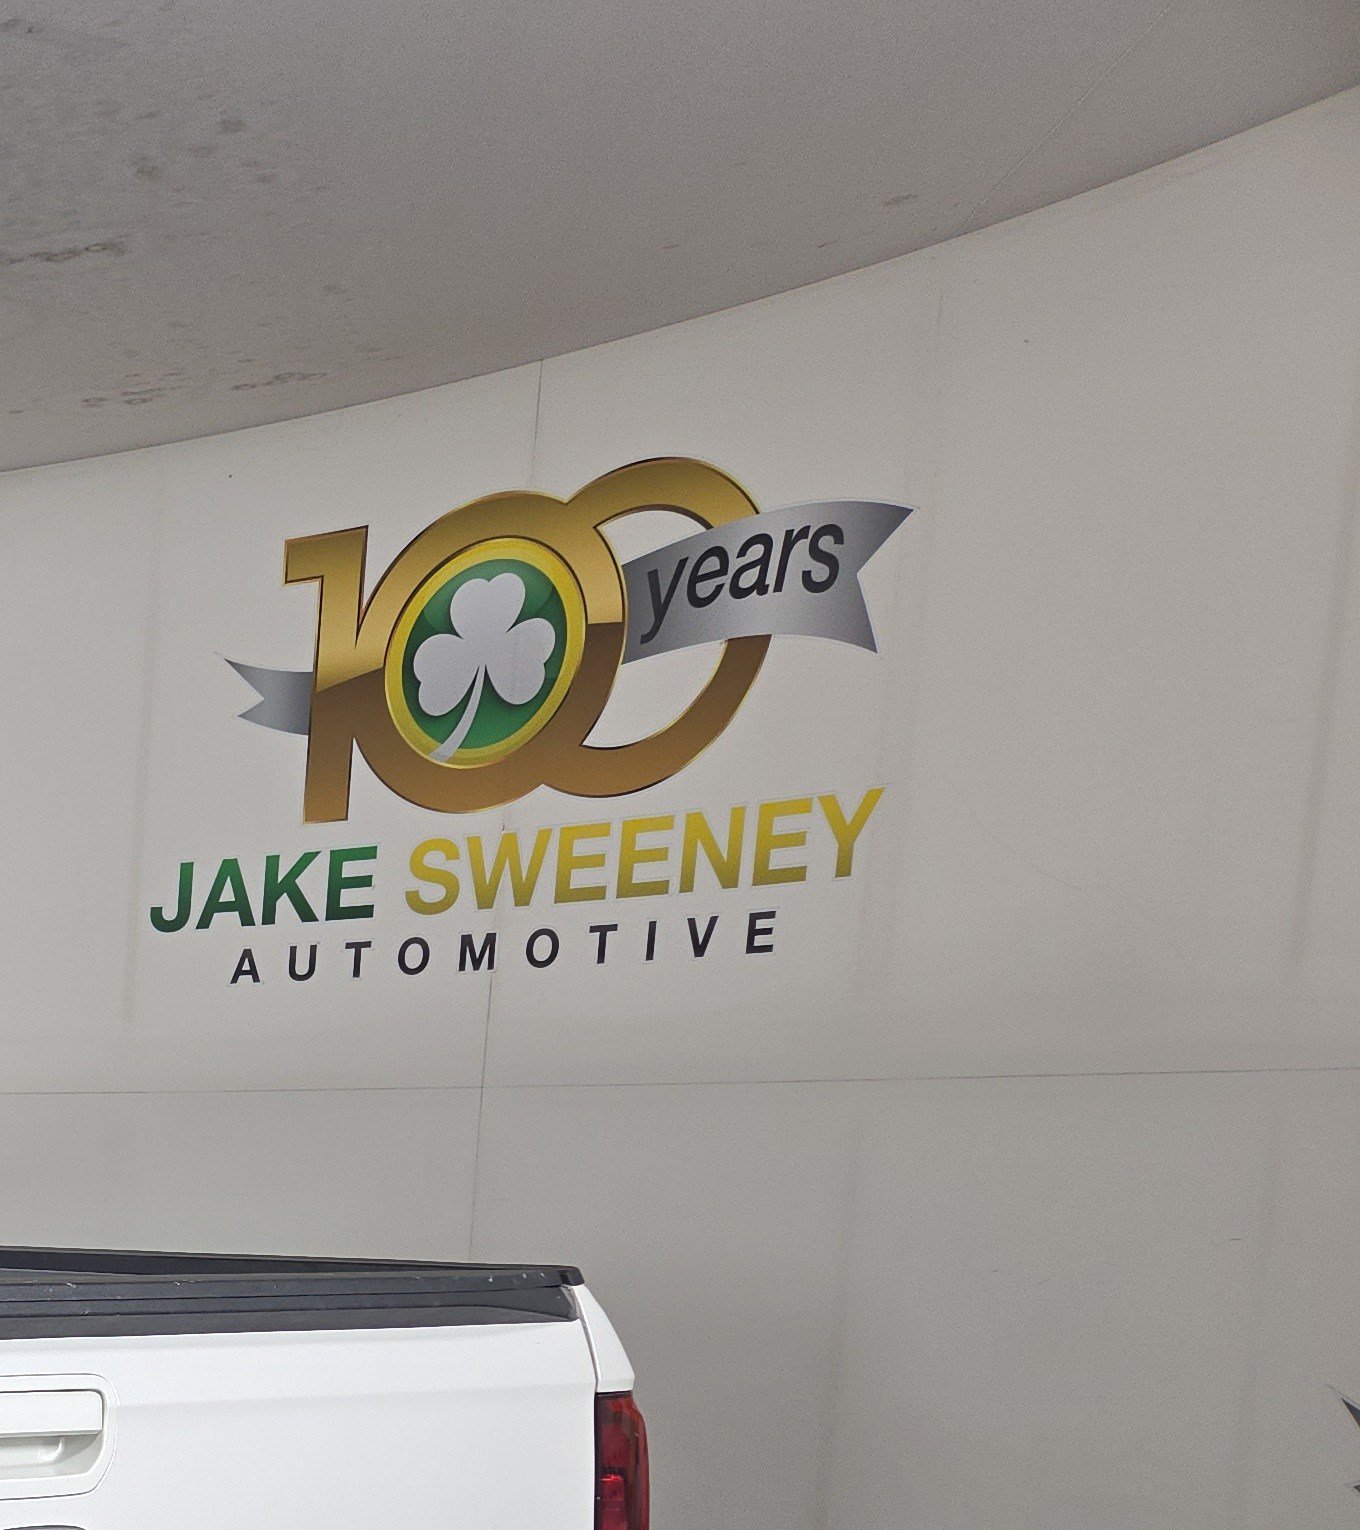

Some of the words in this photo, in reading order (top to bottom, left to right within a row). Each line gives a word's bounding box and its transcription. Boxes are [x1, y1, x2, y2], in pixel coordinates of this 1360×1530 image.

[639, 522, 845, 645] years
[149, 845, 378, 934] JAKE
[404, 786, 887, 916] SWEENEY
[229, 909, 778, 985] AUTOMOTIVE
